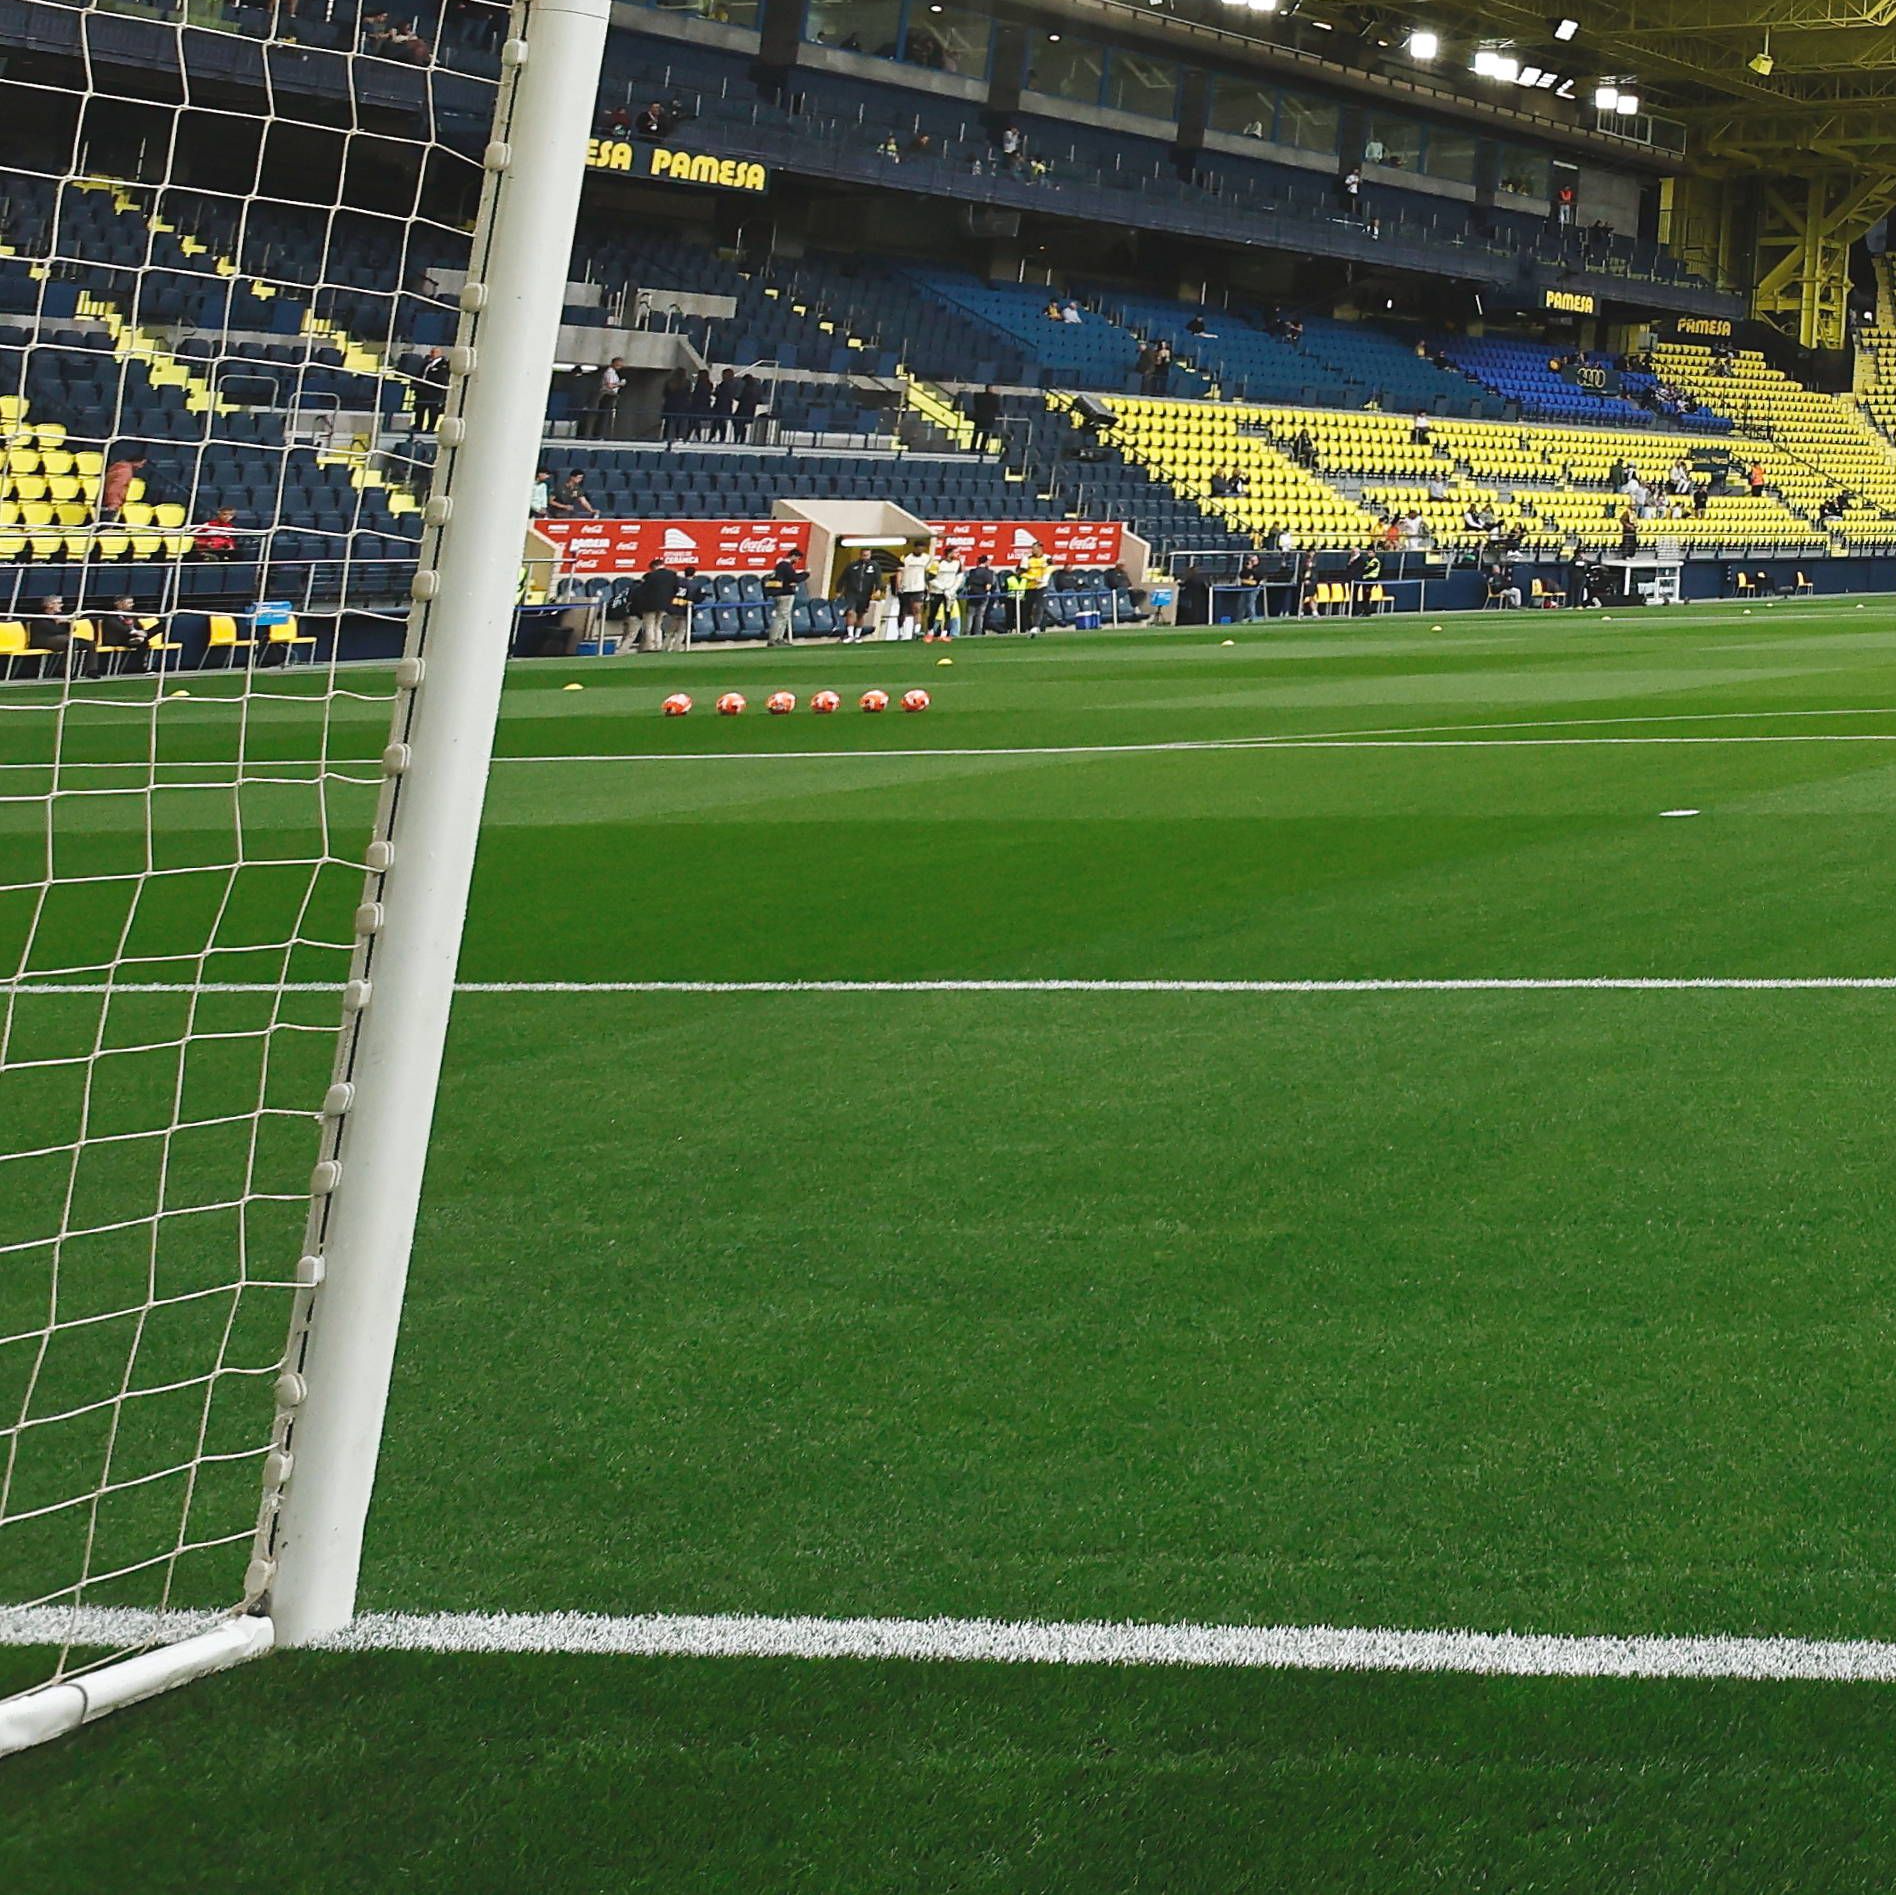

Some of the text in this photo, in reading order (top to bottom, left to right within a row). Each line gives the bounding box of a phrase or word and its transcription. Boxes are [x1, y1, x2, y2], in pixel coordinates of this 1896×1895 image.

[584, 138, 632, 171] ESA
[650, 148, 766, 191] PAMESA
[1546, 290, 1594, 314] PAMESA
[1677, 318, 1731, 336] PAMESA
